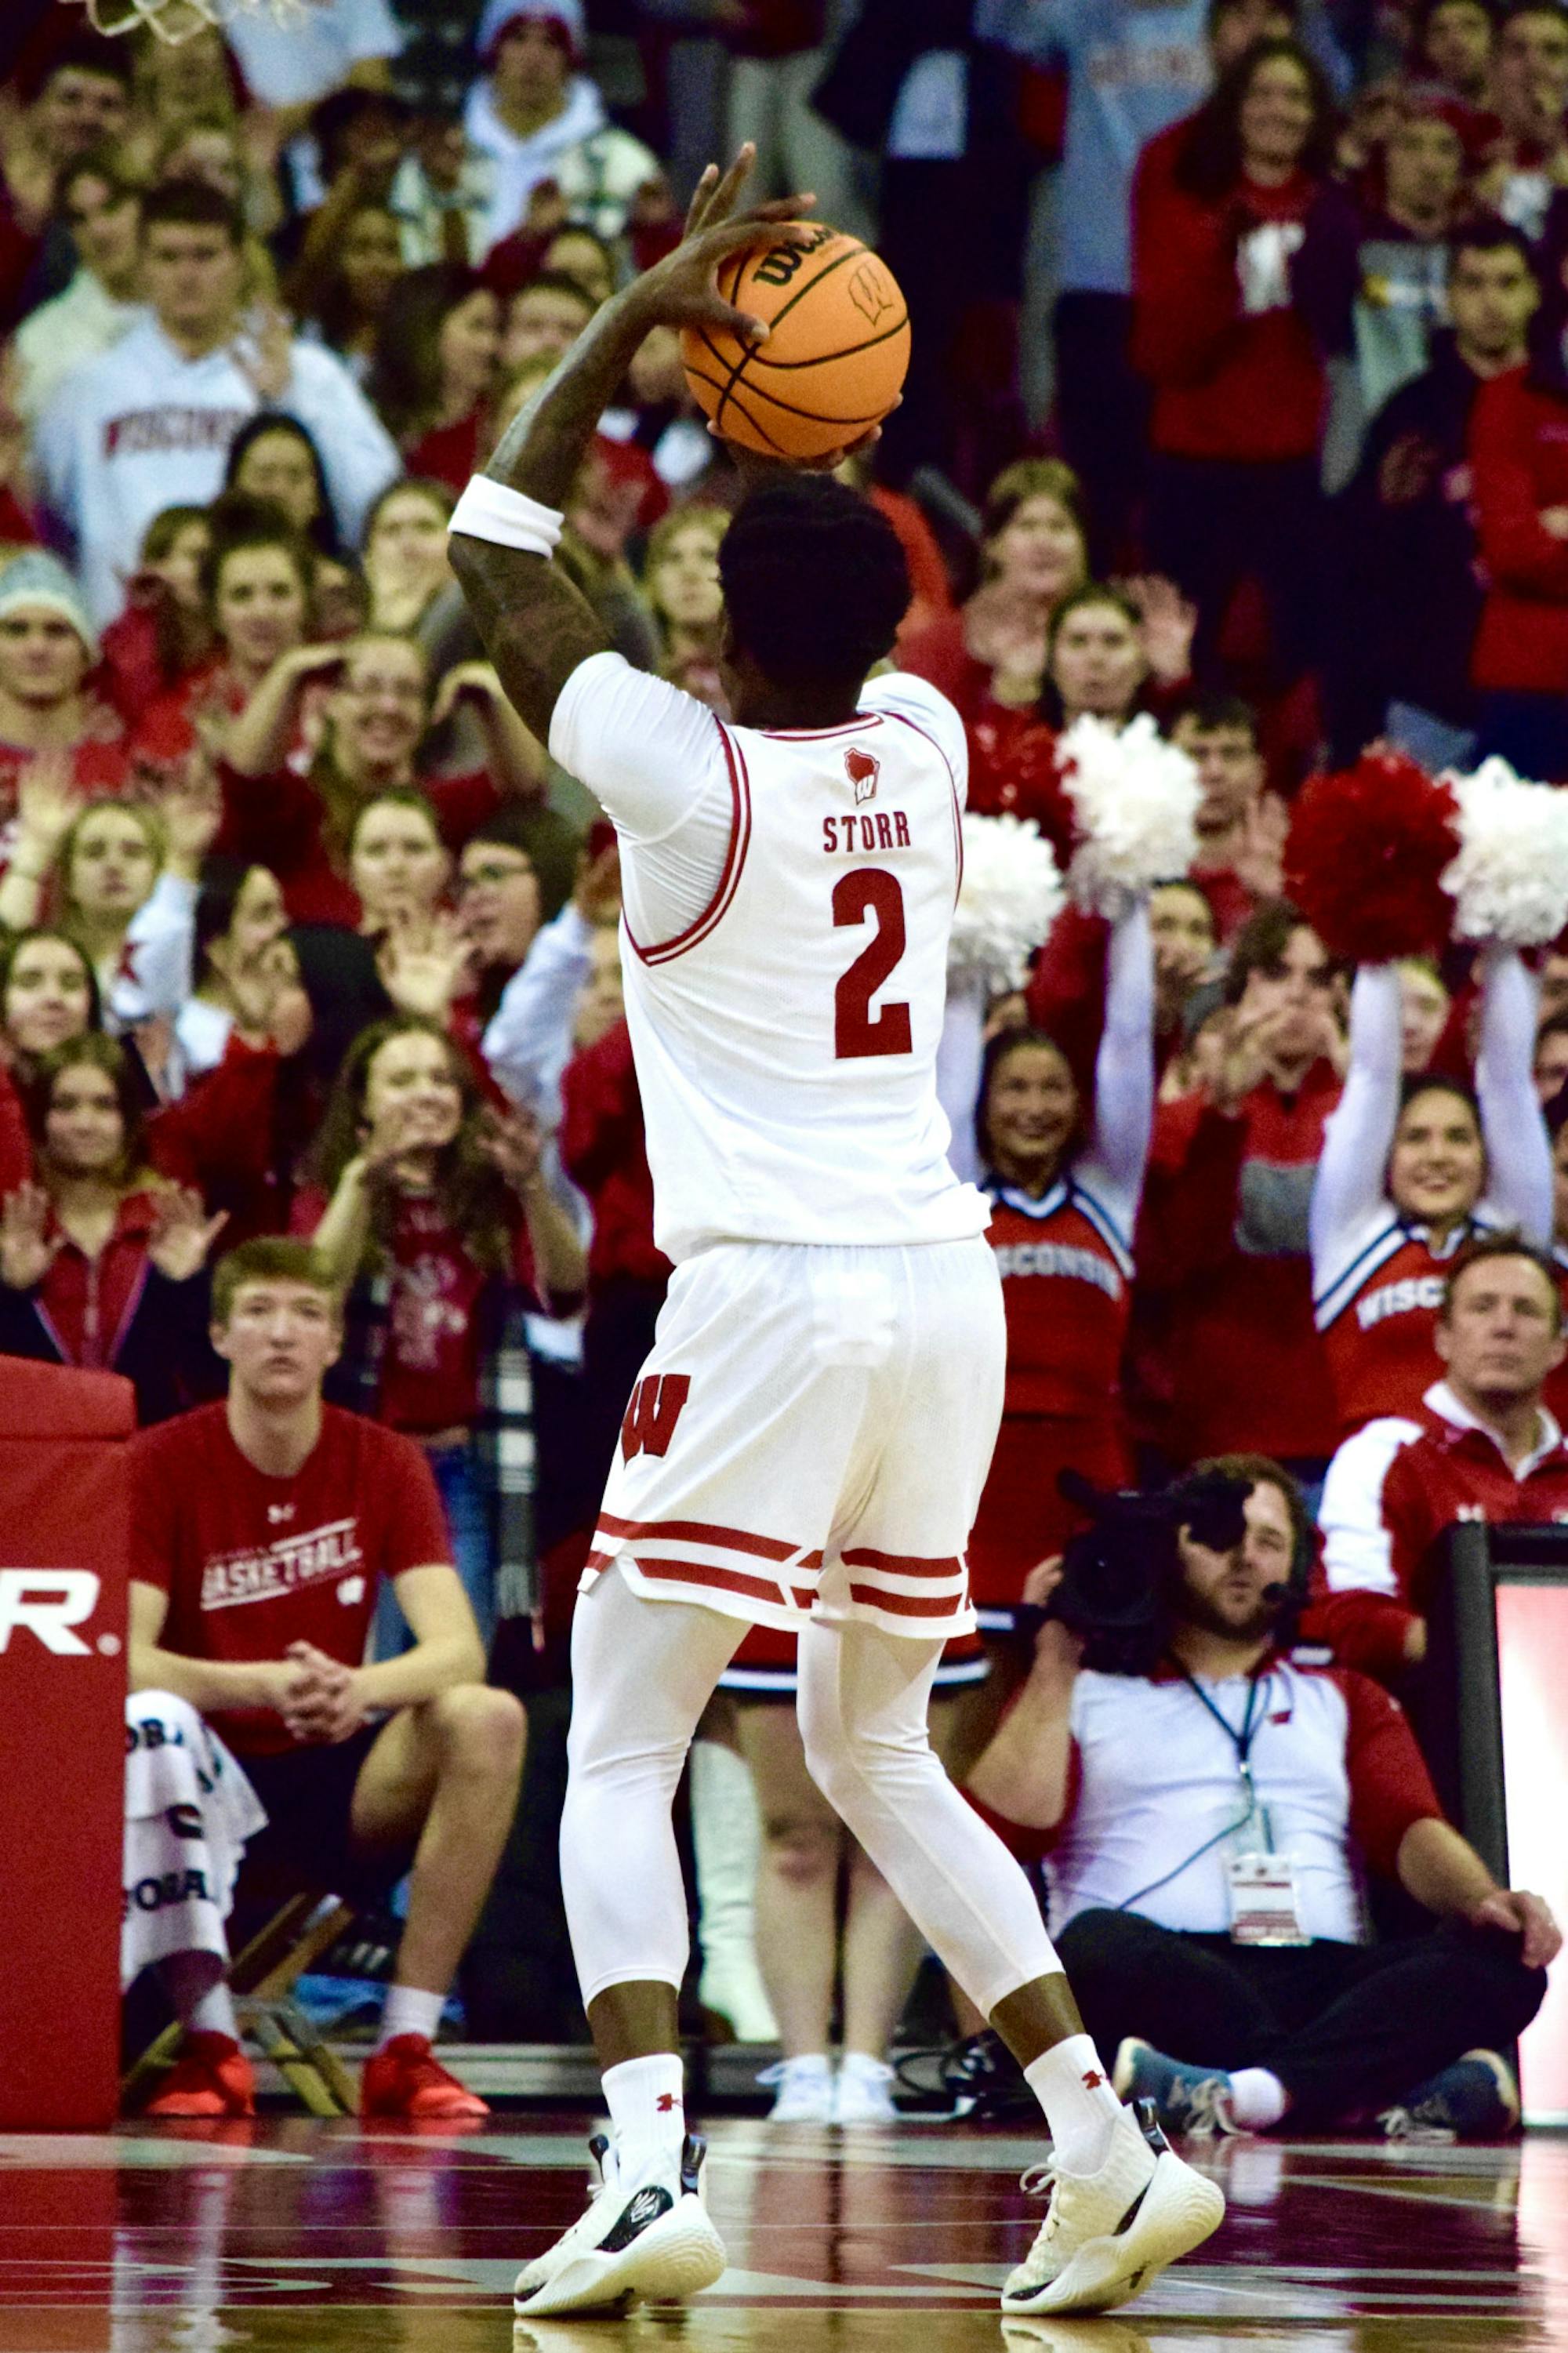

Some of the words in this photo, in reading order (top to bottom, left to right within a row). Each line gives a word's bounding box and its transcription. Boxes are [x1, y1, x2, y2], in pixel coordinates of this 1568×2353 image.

[823, 811, 911, 852] STORR
[832, 868, 913, 1059] 2
[621, 1374, 691, 1471] W
